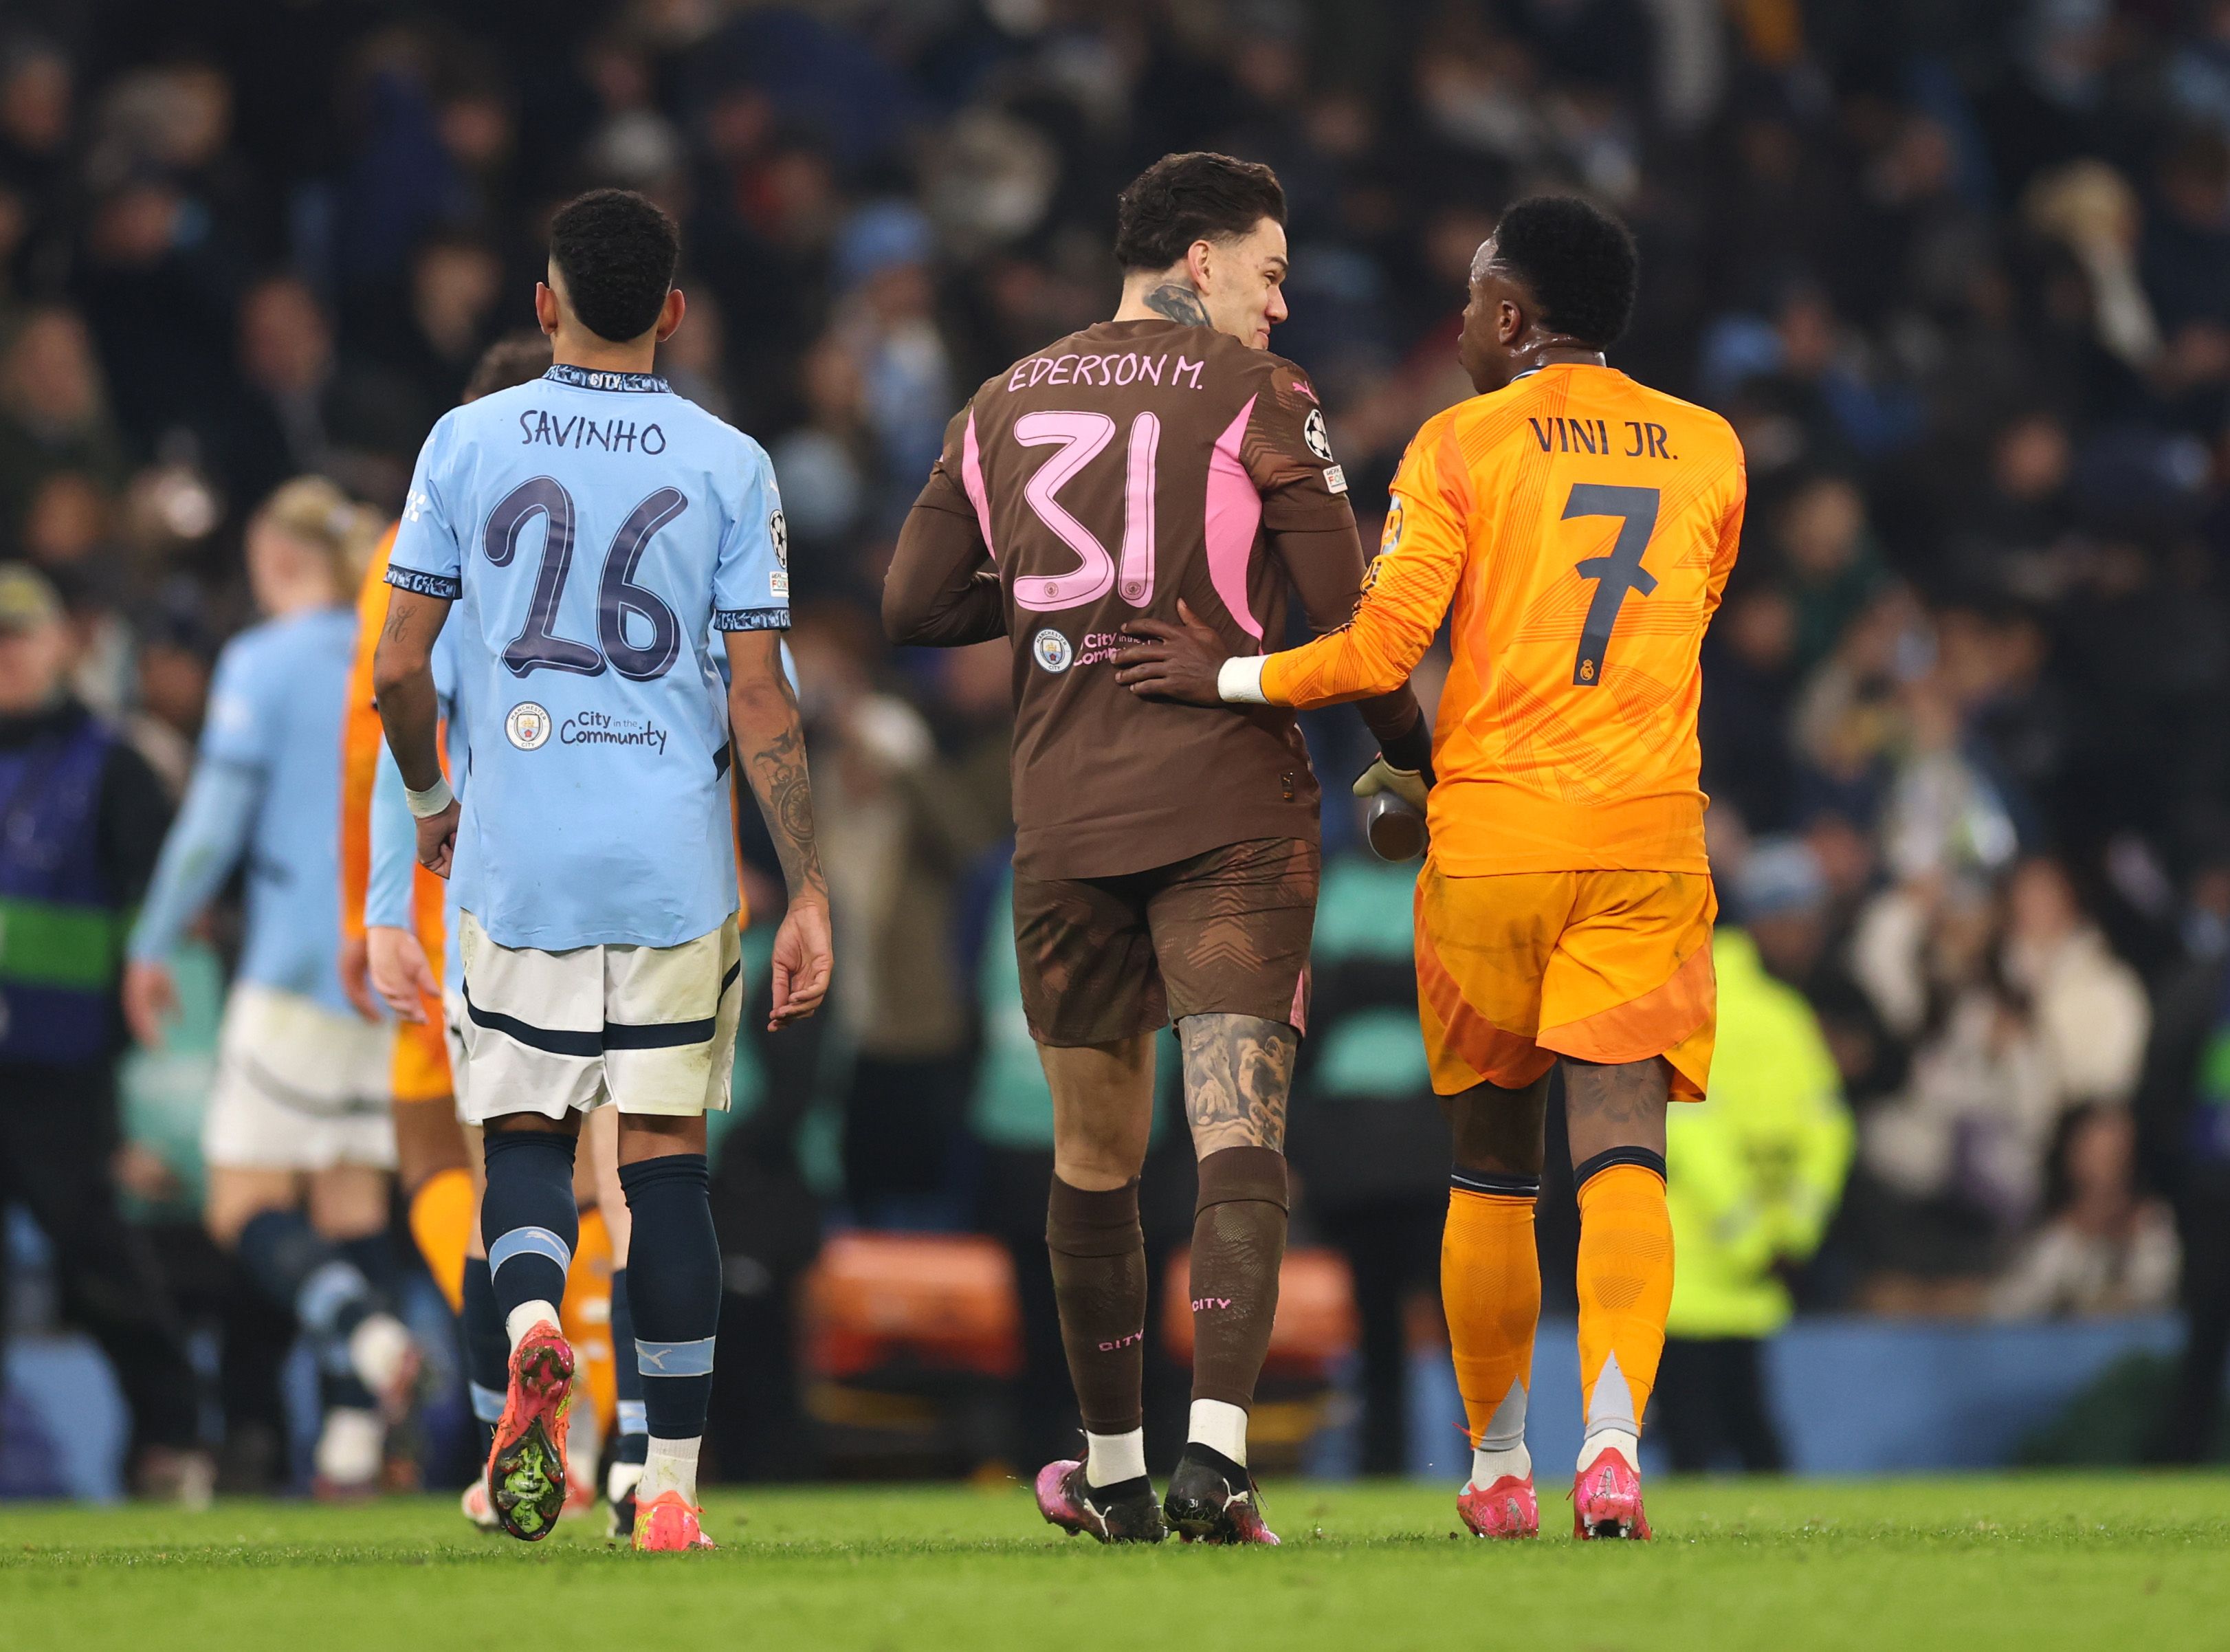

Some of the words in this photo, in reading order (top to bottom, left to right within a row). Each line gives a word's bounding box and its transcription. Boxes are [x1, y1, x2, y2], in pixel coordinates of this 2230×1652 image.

[589, 373, 621, 388] CITY
[1008, 353, 1167, 393] EDERSON
[1171, 355, 1204, 389] M.
[520, 410, 666, 455] SAVINHO
[1528, 417, 1609, 455] VINI
[1624, 421, 1678, 460] JR.
[1013, 410, 1160, 612] 31
[483, 475, 688, 682] 26
[1560, 483, 1660, 686] 7
[1036, 630, 1067, 646] MANCHESTER
[1084, 632, 1117, 649] City
[511, 705, 547, 720] MANCHESTER
[578, 711, 611, 729] City
[613, 719, 621, 727] in
[623, 719, 638, 727] the
[560, 719, 667, 756] Community
[1192, 1298, 1230, 1312] CITY
[1099, 1328, 1144, 1352] CITY
[1189, 1498, 1199, 1508] 31
